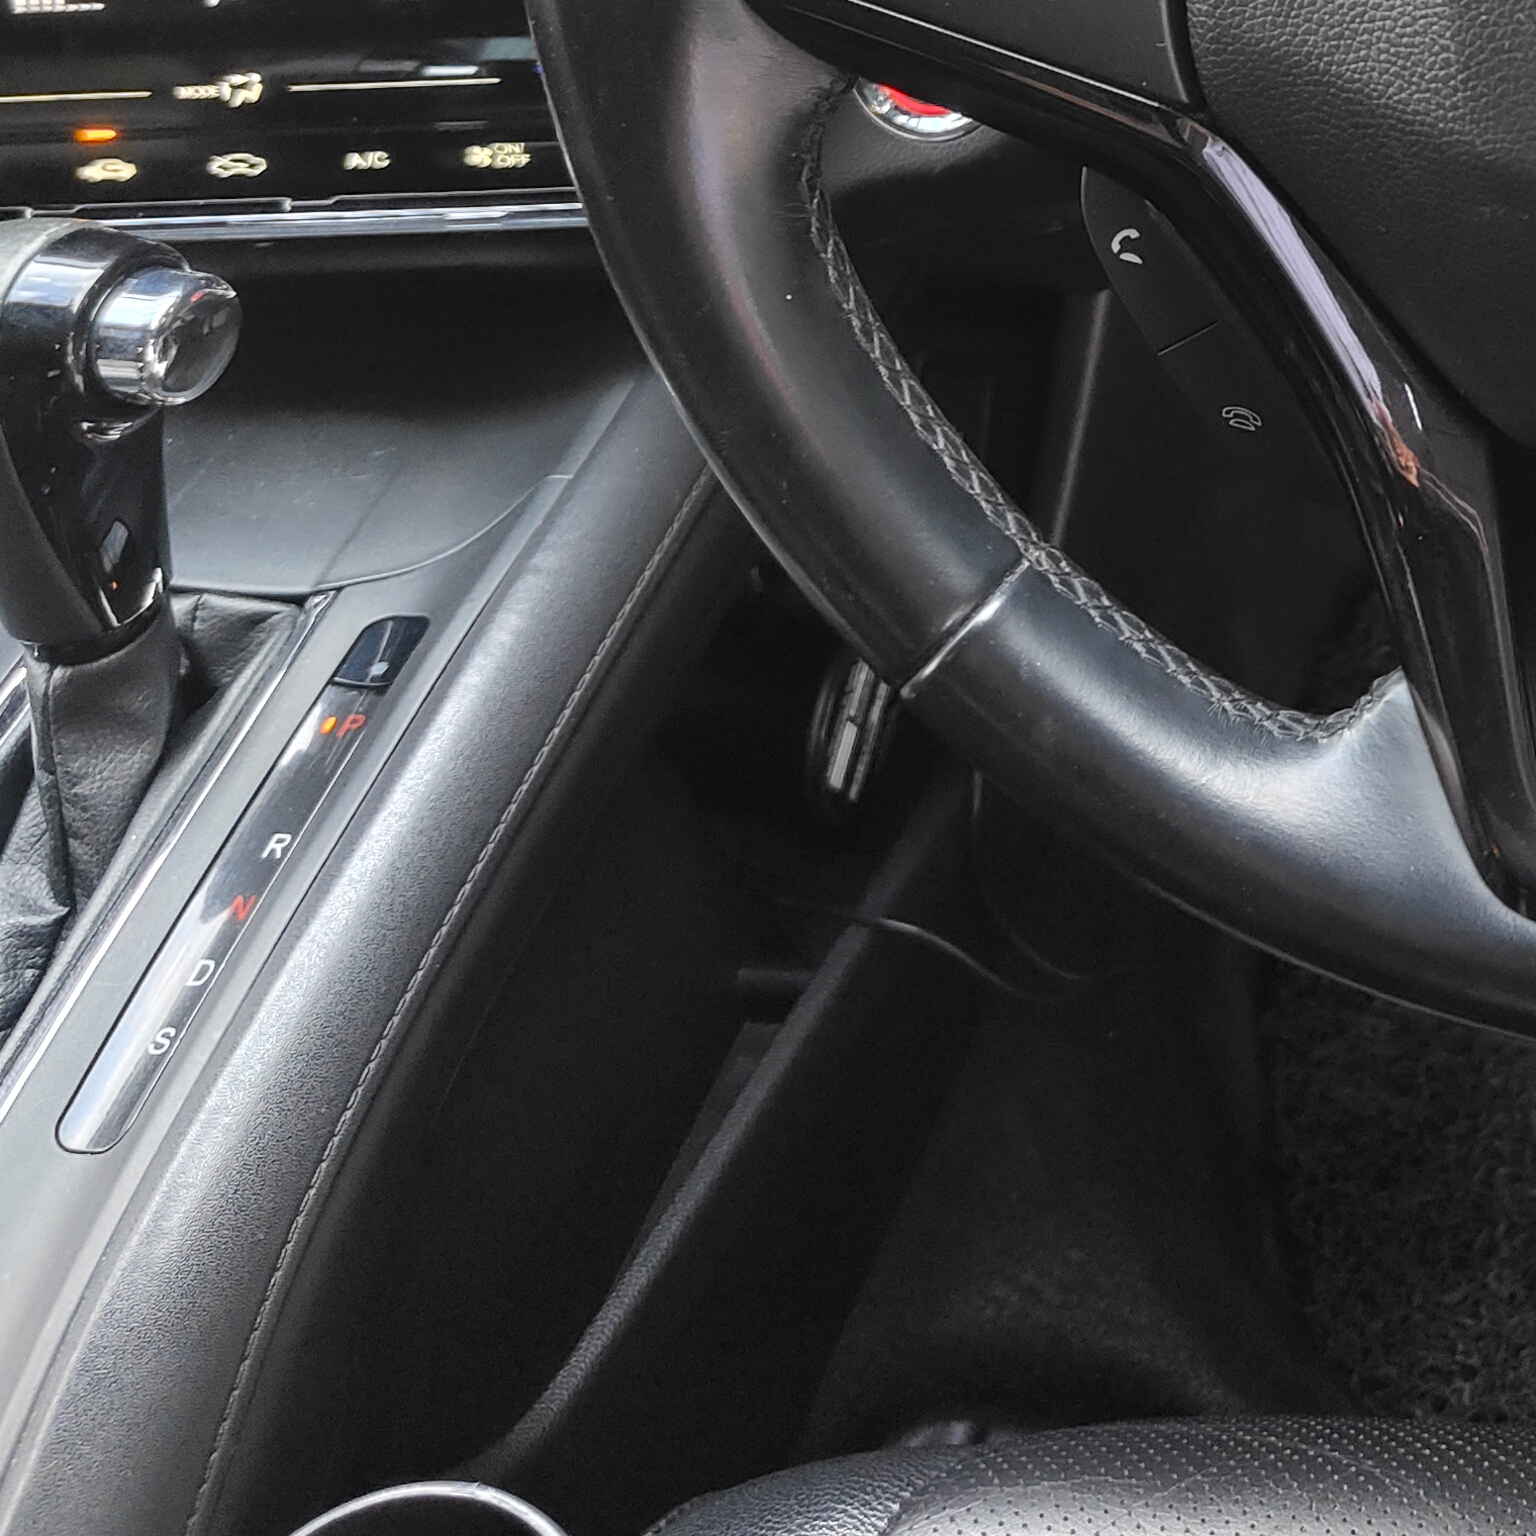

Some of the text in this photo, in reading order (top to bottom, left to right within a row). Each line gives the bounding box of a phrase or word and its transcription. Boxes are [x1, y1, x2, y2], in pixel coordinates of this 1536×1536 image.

[173, 85, 220, 100] MODE
[342, 150, 392, 171] A/C
[336, 714, 366, 737] P
[261, 833, 292, 860] R
[227, 894, 257, 922] N
[186, 959, 216, 987] D
[147, 1026, 177, 1056] S
